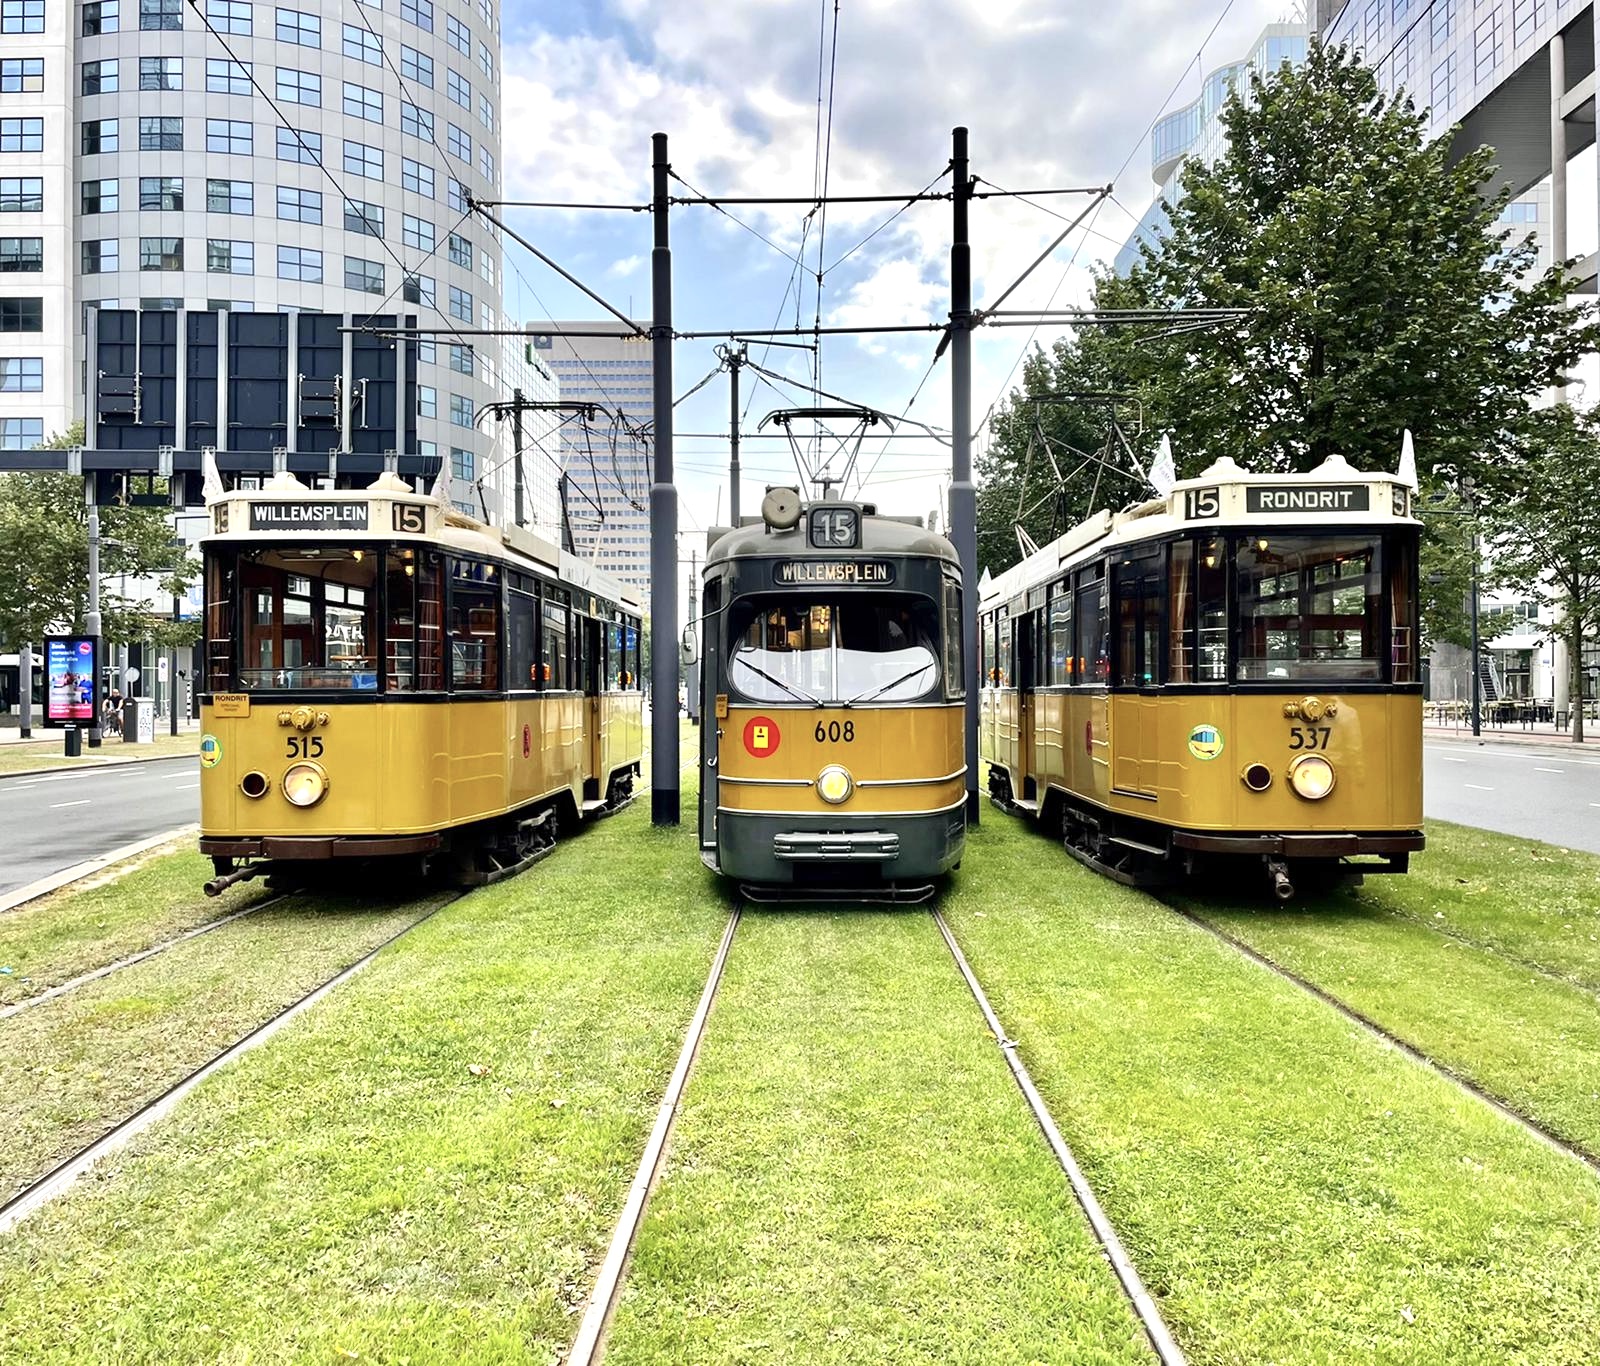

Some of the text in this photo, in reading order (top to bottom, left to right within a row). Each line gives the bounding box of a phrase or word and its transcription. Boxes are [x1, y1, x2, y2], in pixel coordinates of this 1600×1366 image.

[1188, 489, 1219, 518] 15
[1260, 491, 1354, 508] RONDRIT
[254, 505, 367, 521] WILLEMSPLEIN
[393, 505, 423, 533] 15
[821, 514, 851, 542] 15
[782, 564, 888, 581] WILLEMSPLEIN
[814, 720, 855, 743] 608
[1288, 727, 1331, 750] 537
[286, 736, 324, 759] 515
